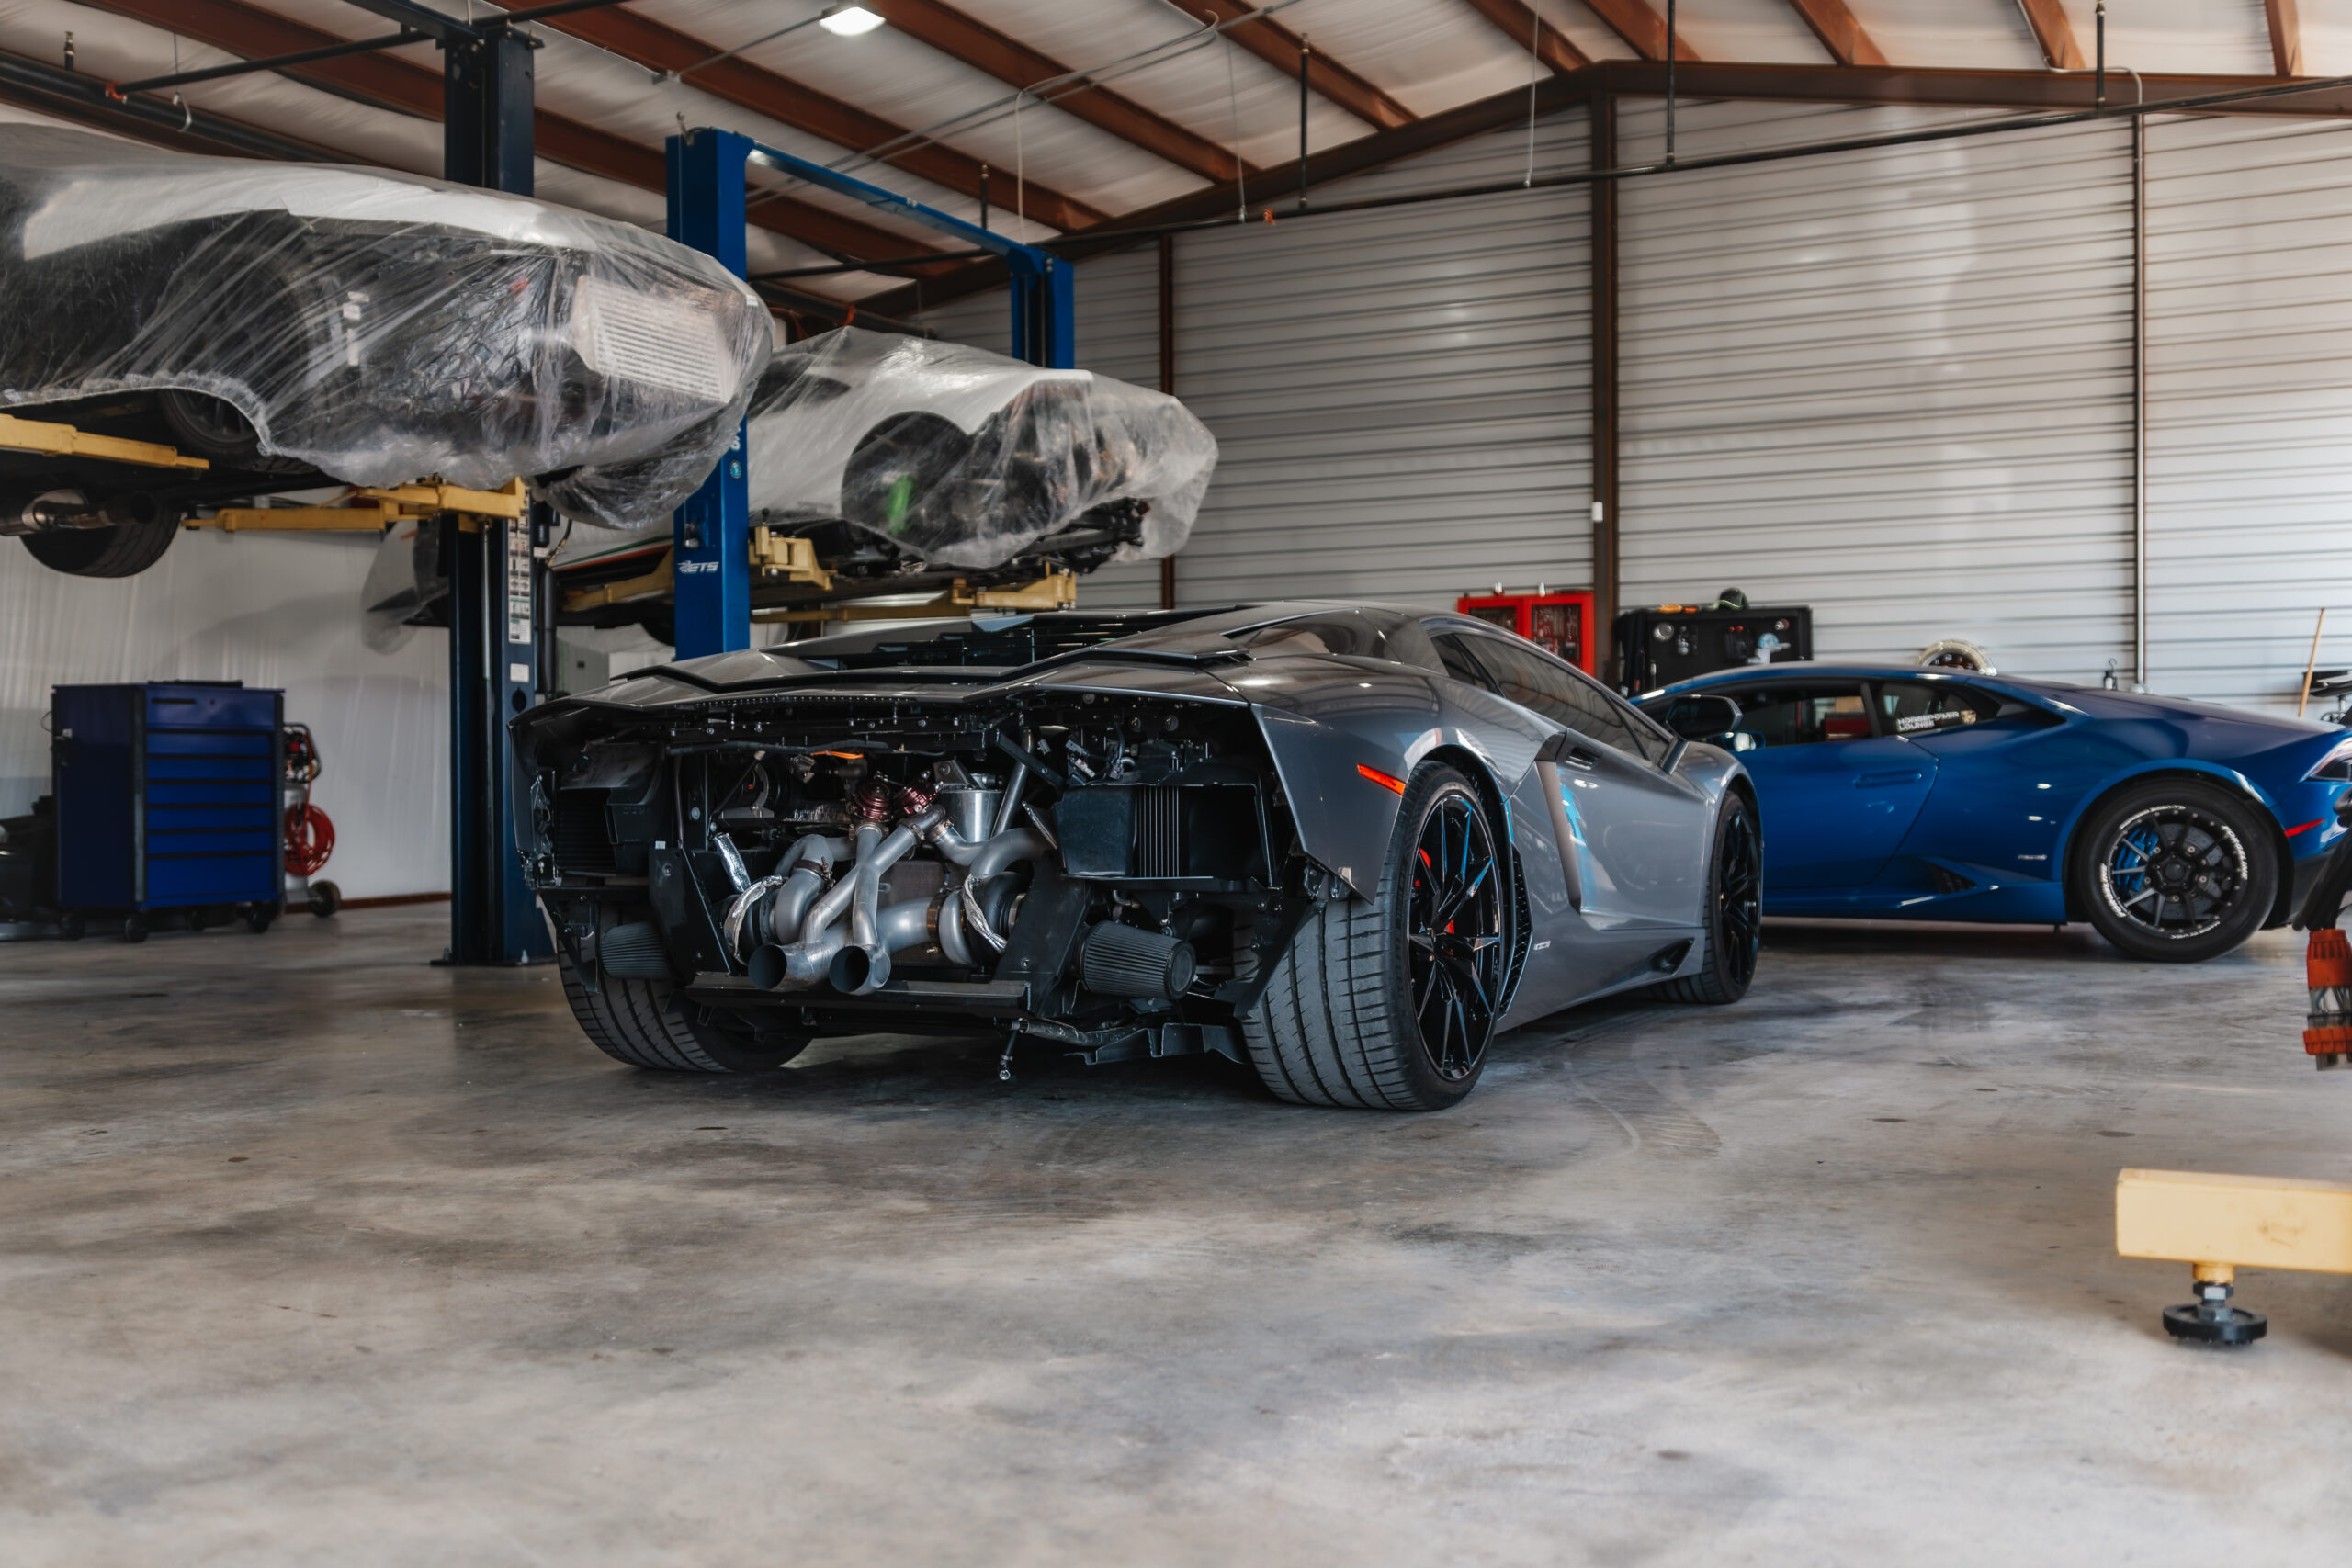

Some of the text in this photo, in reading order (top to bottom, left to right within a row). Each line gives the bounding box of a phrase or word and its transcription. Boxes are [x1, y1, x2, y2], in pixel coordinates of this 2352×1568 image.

[1897, 711, 1959, 725] HORSEPOWER
[1897, 720, 1934, 731] LOUNGE
[2221, 825, 2248, 880] FORGELINE
